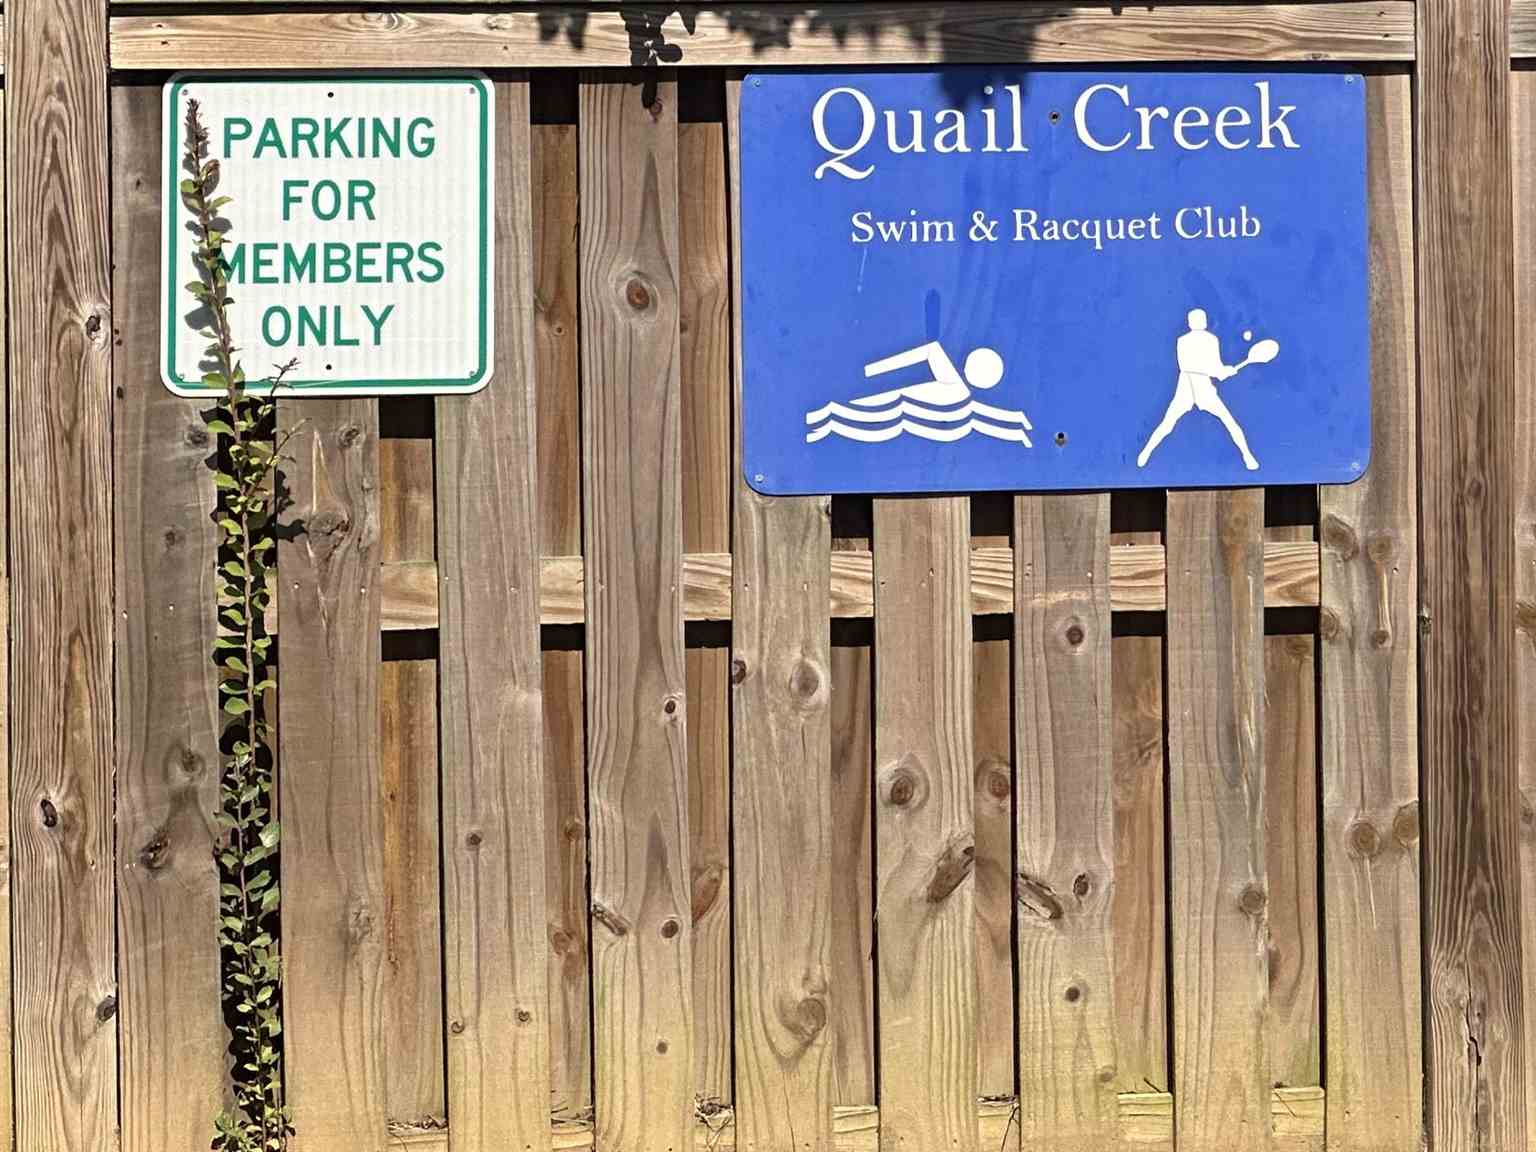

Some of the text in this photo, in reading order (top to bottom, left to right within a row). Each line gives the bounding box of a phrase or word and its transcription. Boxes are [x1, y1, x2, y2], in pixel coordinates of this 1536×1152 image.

[223, 117, 436, 159] PARKING
[813, 82, 1300, 179] Quail Creek
[282, 179, 376, 222] FOR
[851, 205, 1261, 250] Swim & Racquet Club
[220, 241, 445, 284] MEMBERS
[261, 304, 395, 348] ONLY
